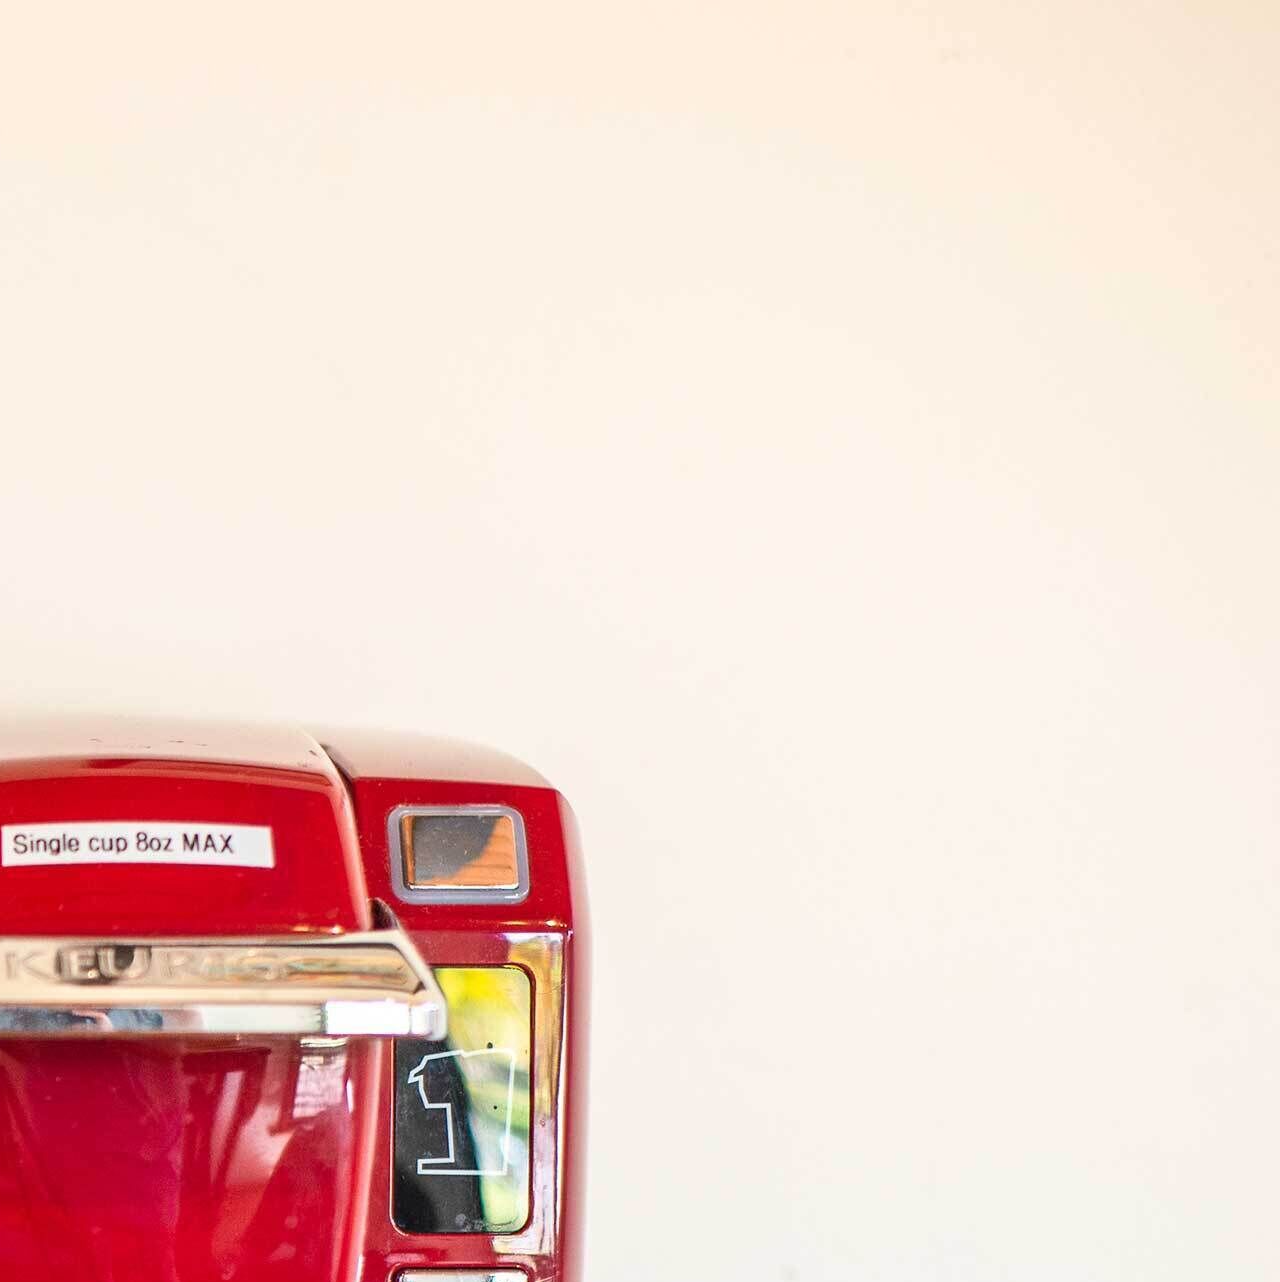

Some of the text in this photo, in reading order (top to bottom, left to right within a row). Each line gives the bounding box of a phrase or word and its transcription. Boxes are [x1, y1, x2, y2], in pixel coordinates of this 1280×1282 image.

[13, 832, 235, 855] Single cup 8oz MAX
